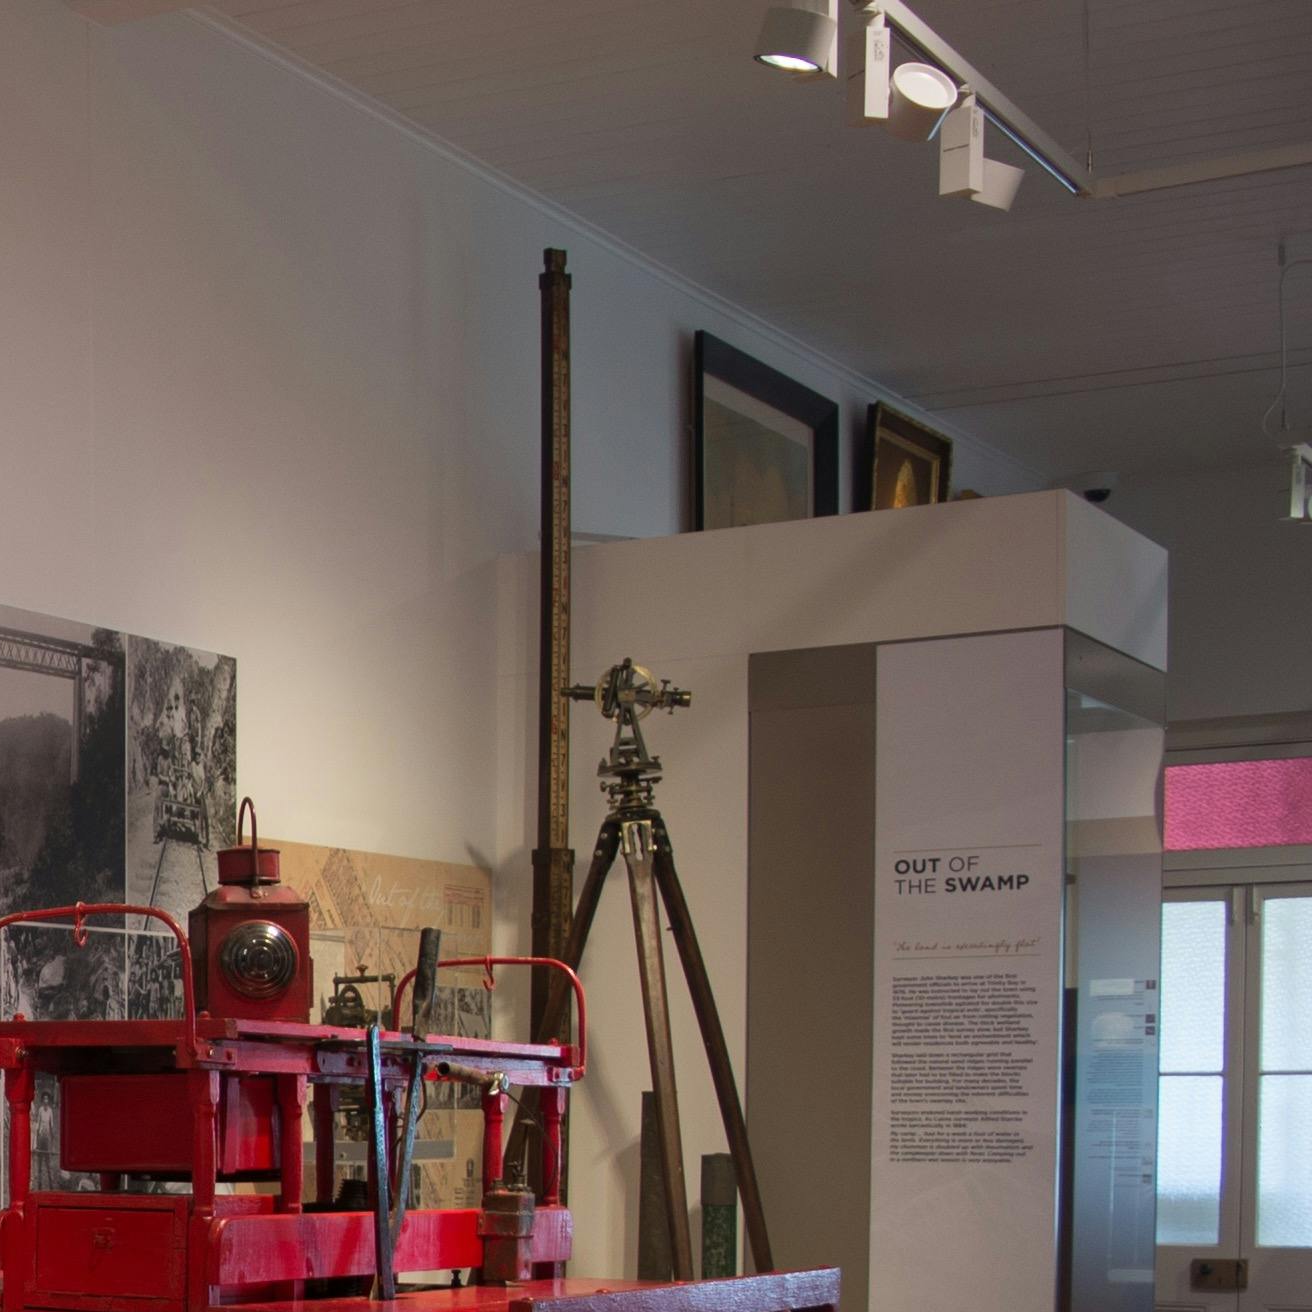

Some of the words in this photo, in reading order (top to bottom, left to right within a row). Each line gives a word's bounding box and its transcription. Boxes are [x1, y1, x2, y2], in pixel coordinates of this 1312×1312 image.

[894, 858, 941, 875] OUT
[948, 855, 979, 872] OF
[894, 878, 936, 895] THE
[944, 874, 1030, 893] SWAMP
